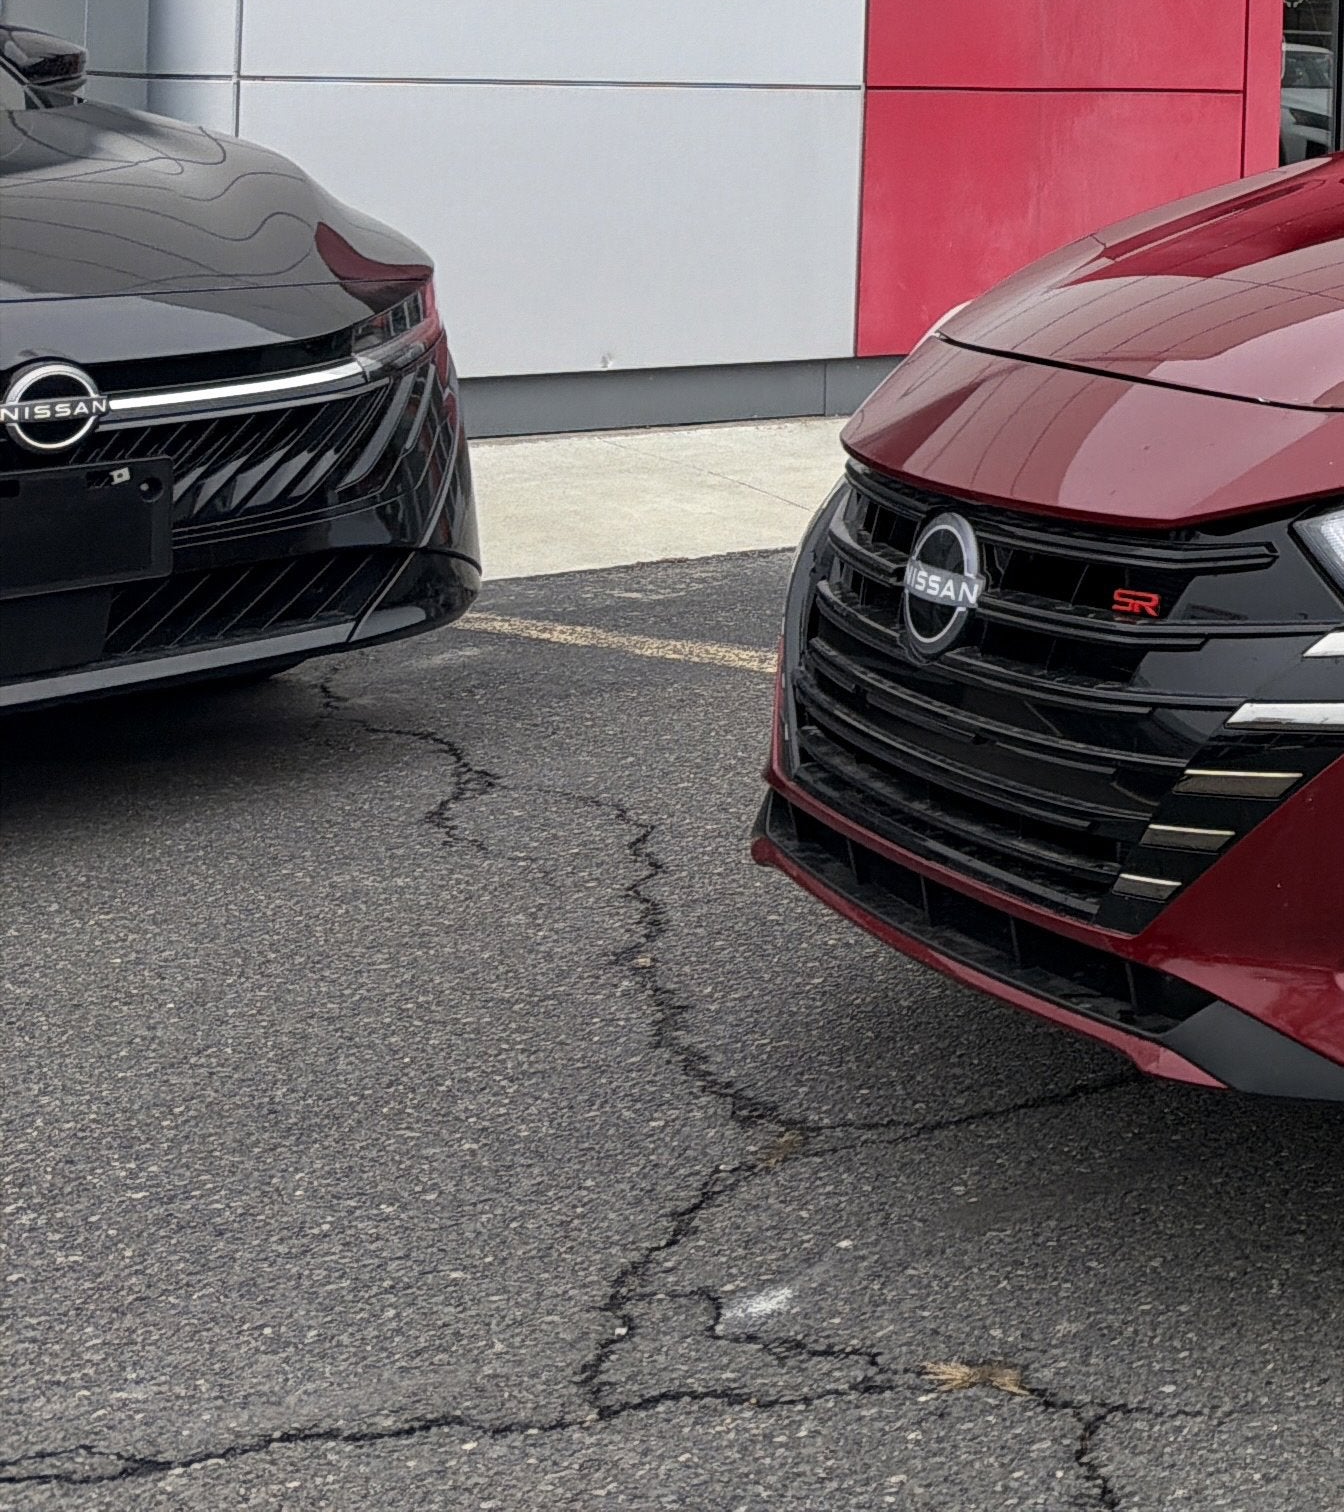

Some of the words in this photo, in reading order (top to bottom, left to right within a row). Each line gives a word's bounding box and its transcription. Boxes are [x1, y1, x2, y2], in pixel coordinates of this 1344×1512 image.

[0, 398, 107, 421] NISSAN
[906, 564, 980, 604] NISSAN
[1111, 588, 1160, 617] SR
